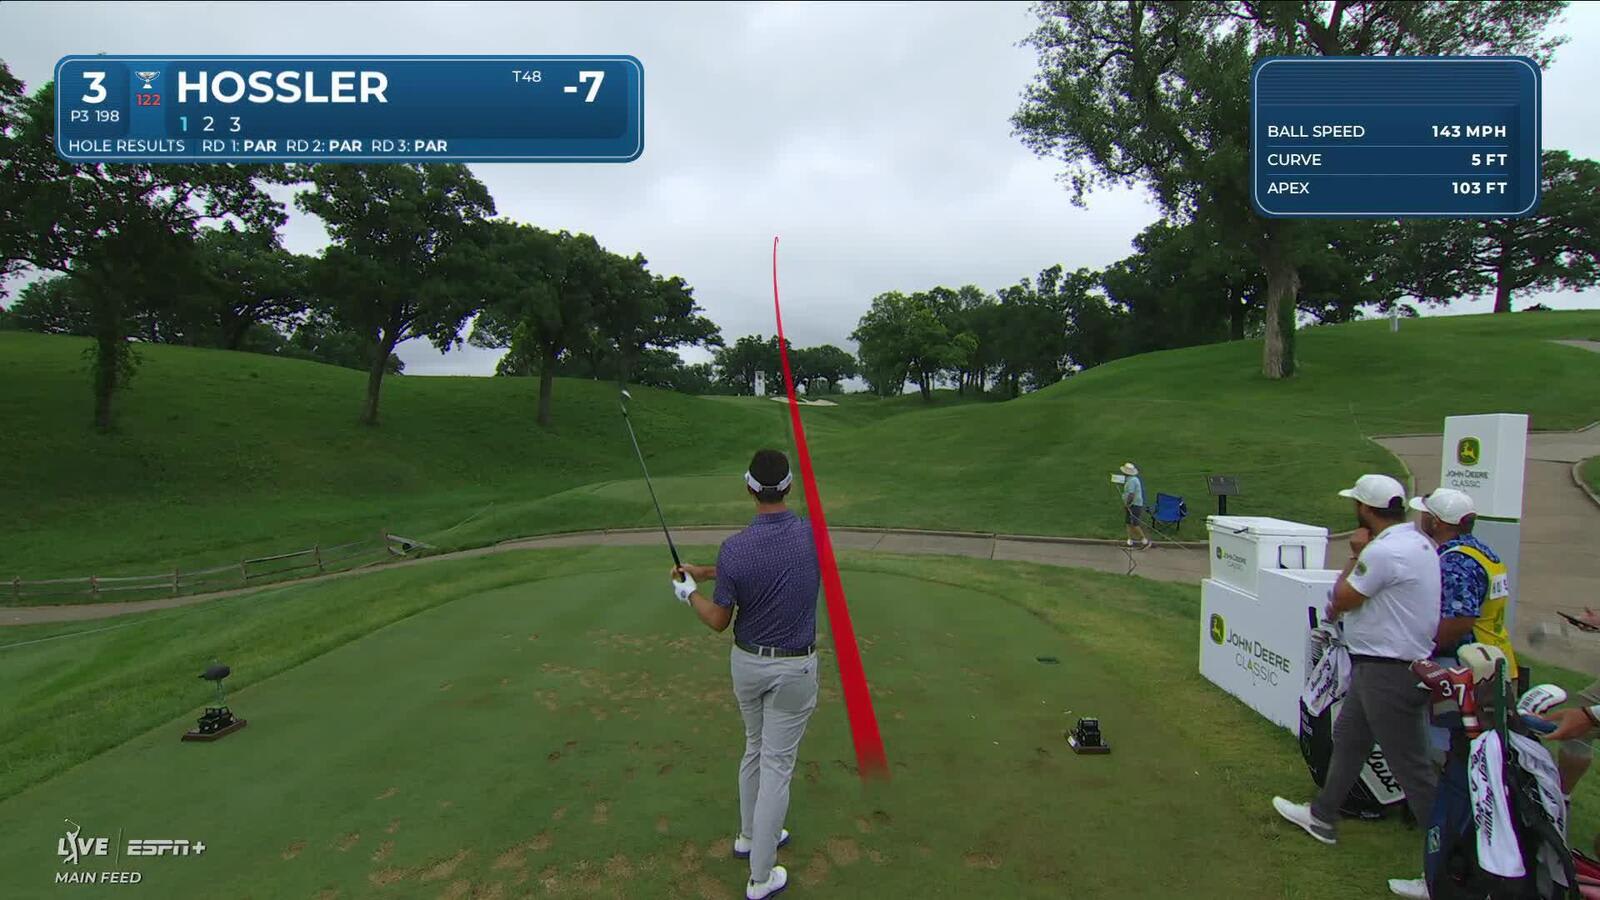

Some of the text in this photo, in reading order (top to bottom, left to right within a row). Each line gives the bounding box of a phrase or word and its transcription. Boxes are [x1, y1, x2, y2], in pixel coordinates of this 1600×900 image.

[1446, 469, 1464, 478] JOHN
[1226, 627, 1291, 674] JOHN DEERE
[1235, 653, 1279, 687] CLASSIC
[1367, 751, 1402, 793] leist
